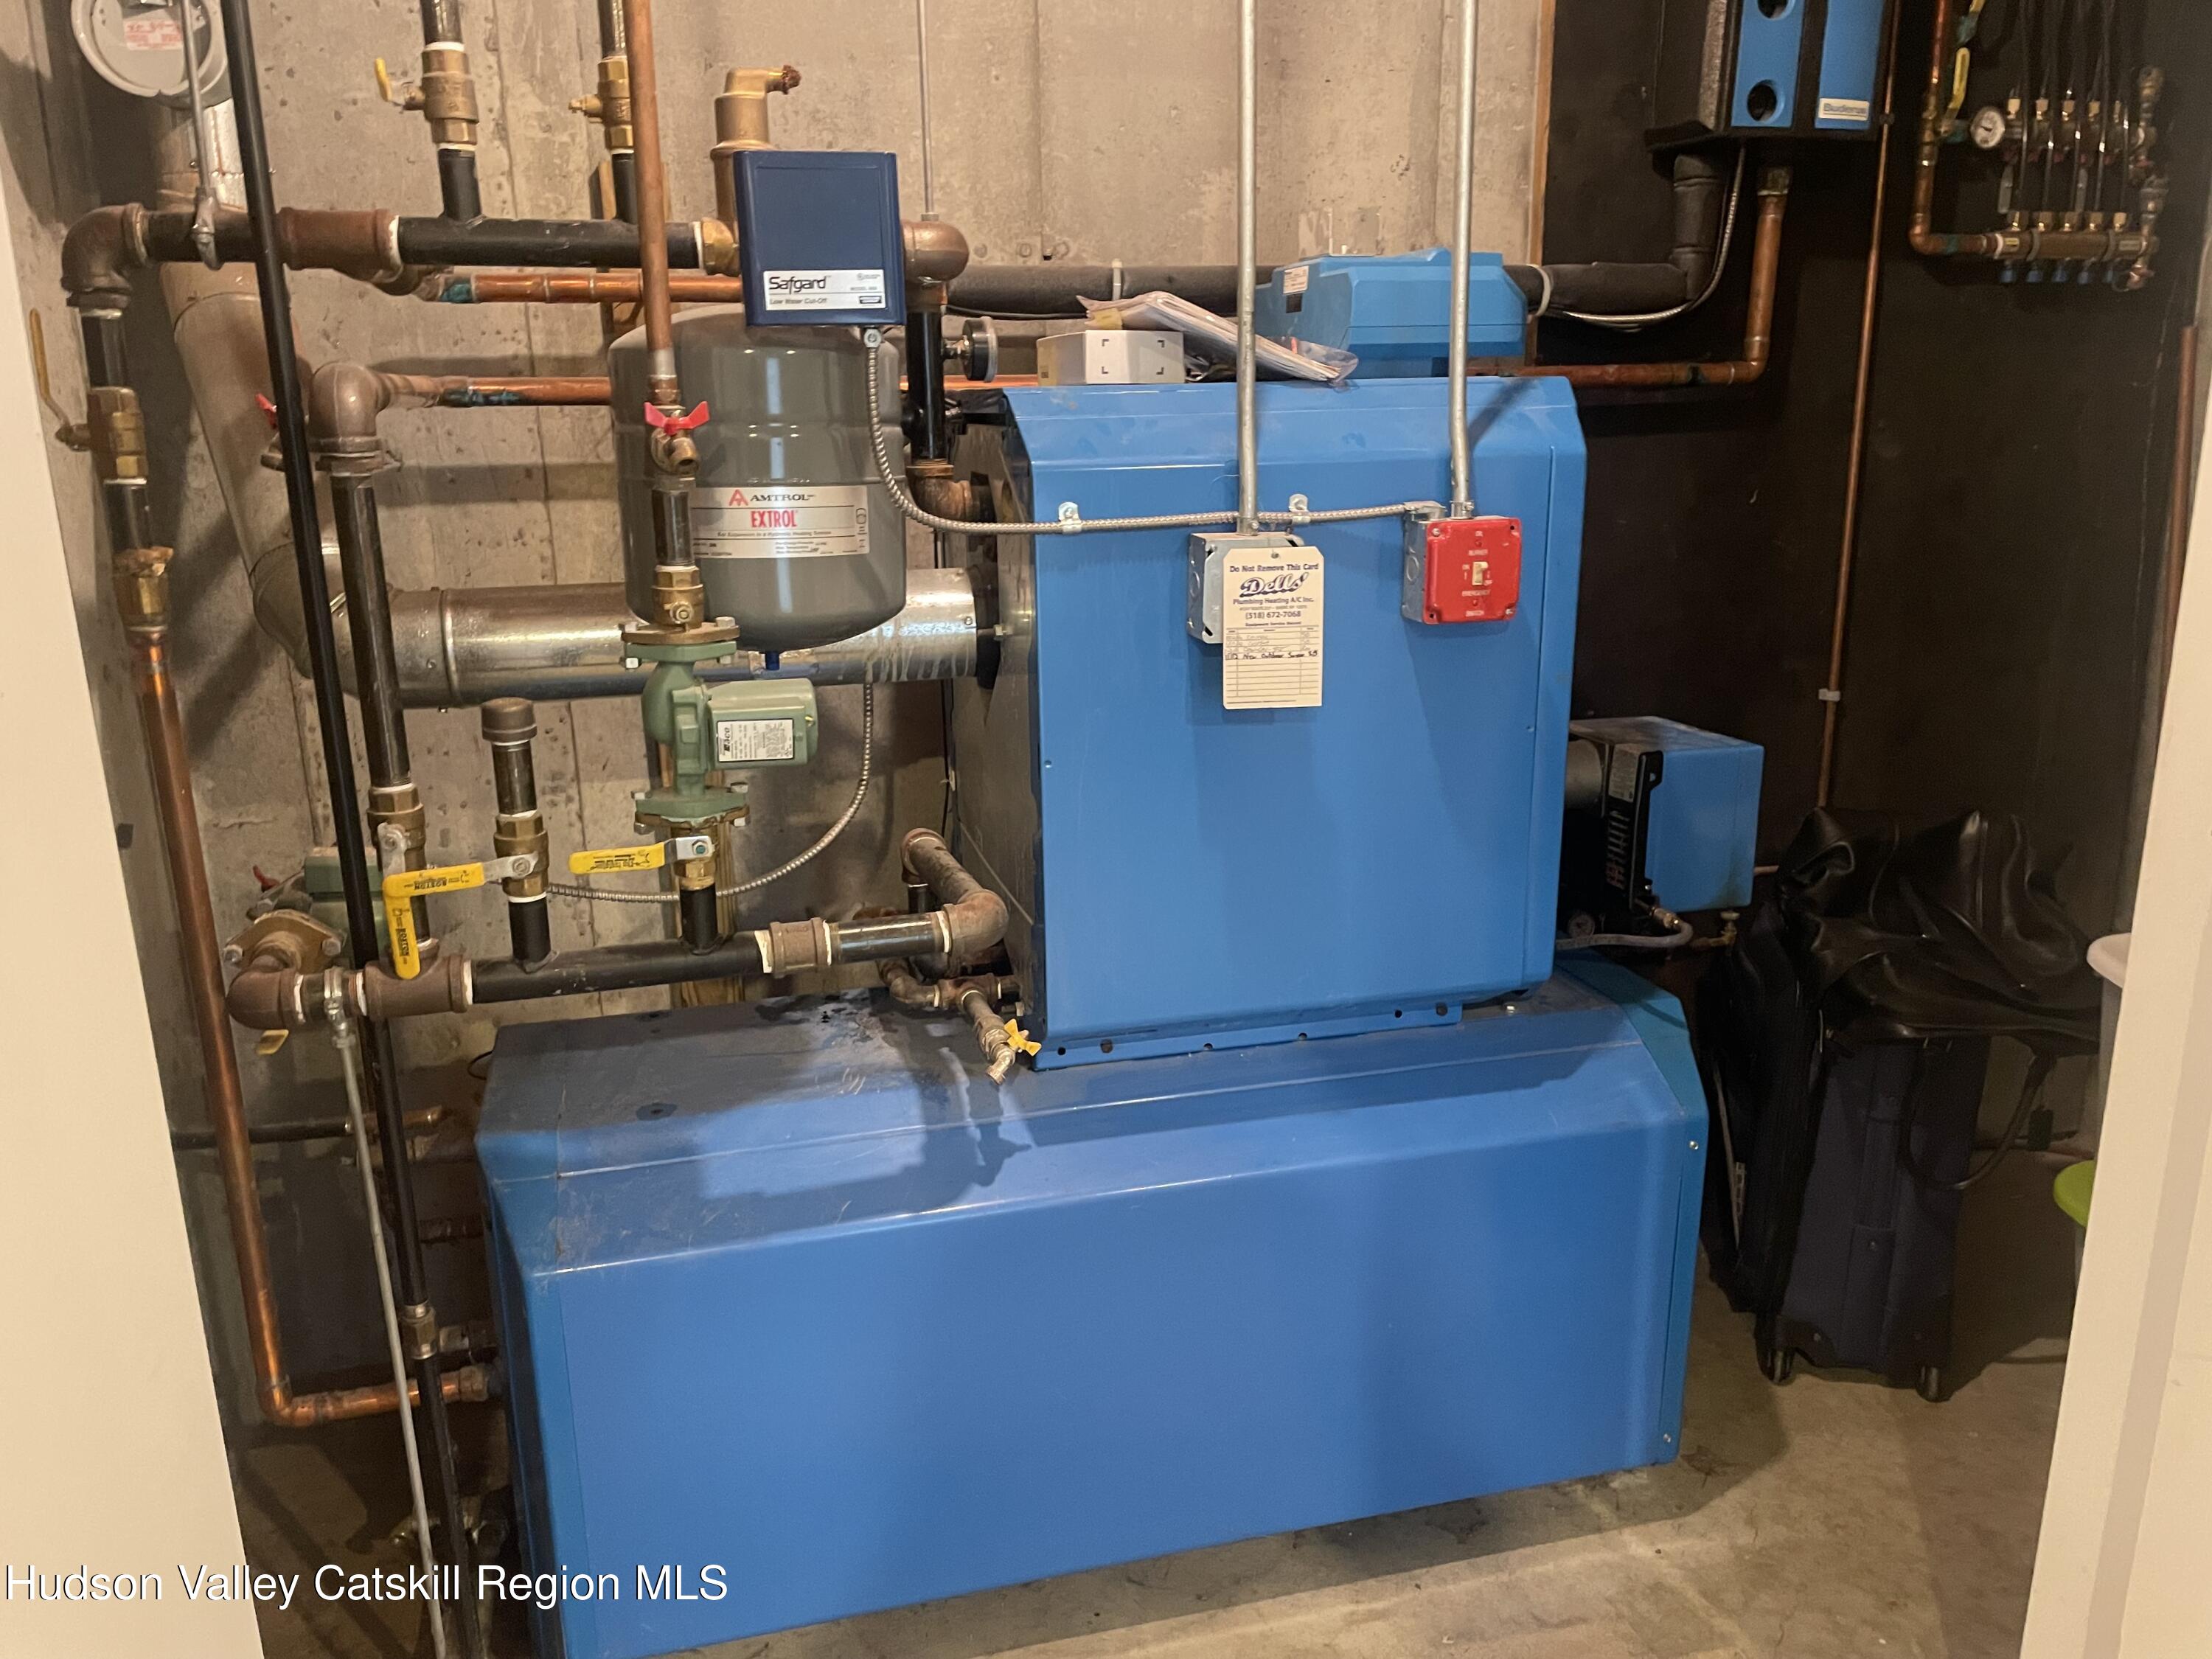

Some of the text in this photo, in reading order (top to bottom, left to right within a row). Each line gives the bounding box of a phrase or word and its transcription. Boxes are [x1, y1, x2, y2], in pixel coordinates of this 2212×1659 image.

[769, 276, 826, 295] Safgard
[750, 493, 810, 502] AMTROL
[751, 510, 797, 528] EXTROL
[1266, 611, 1301, 619] 672-7068
